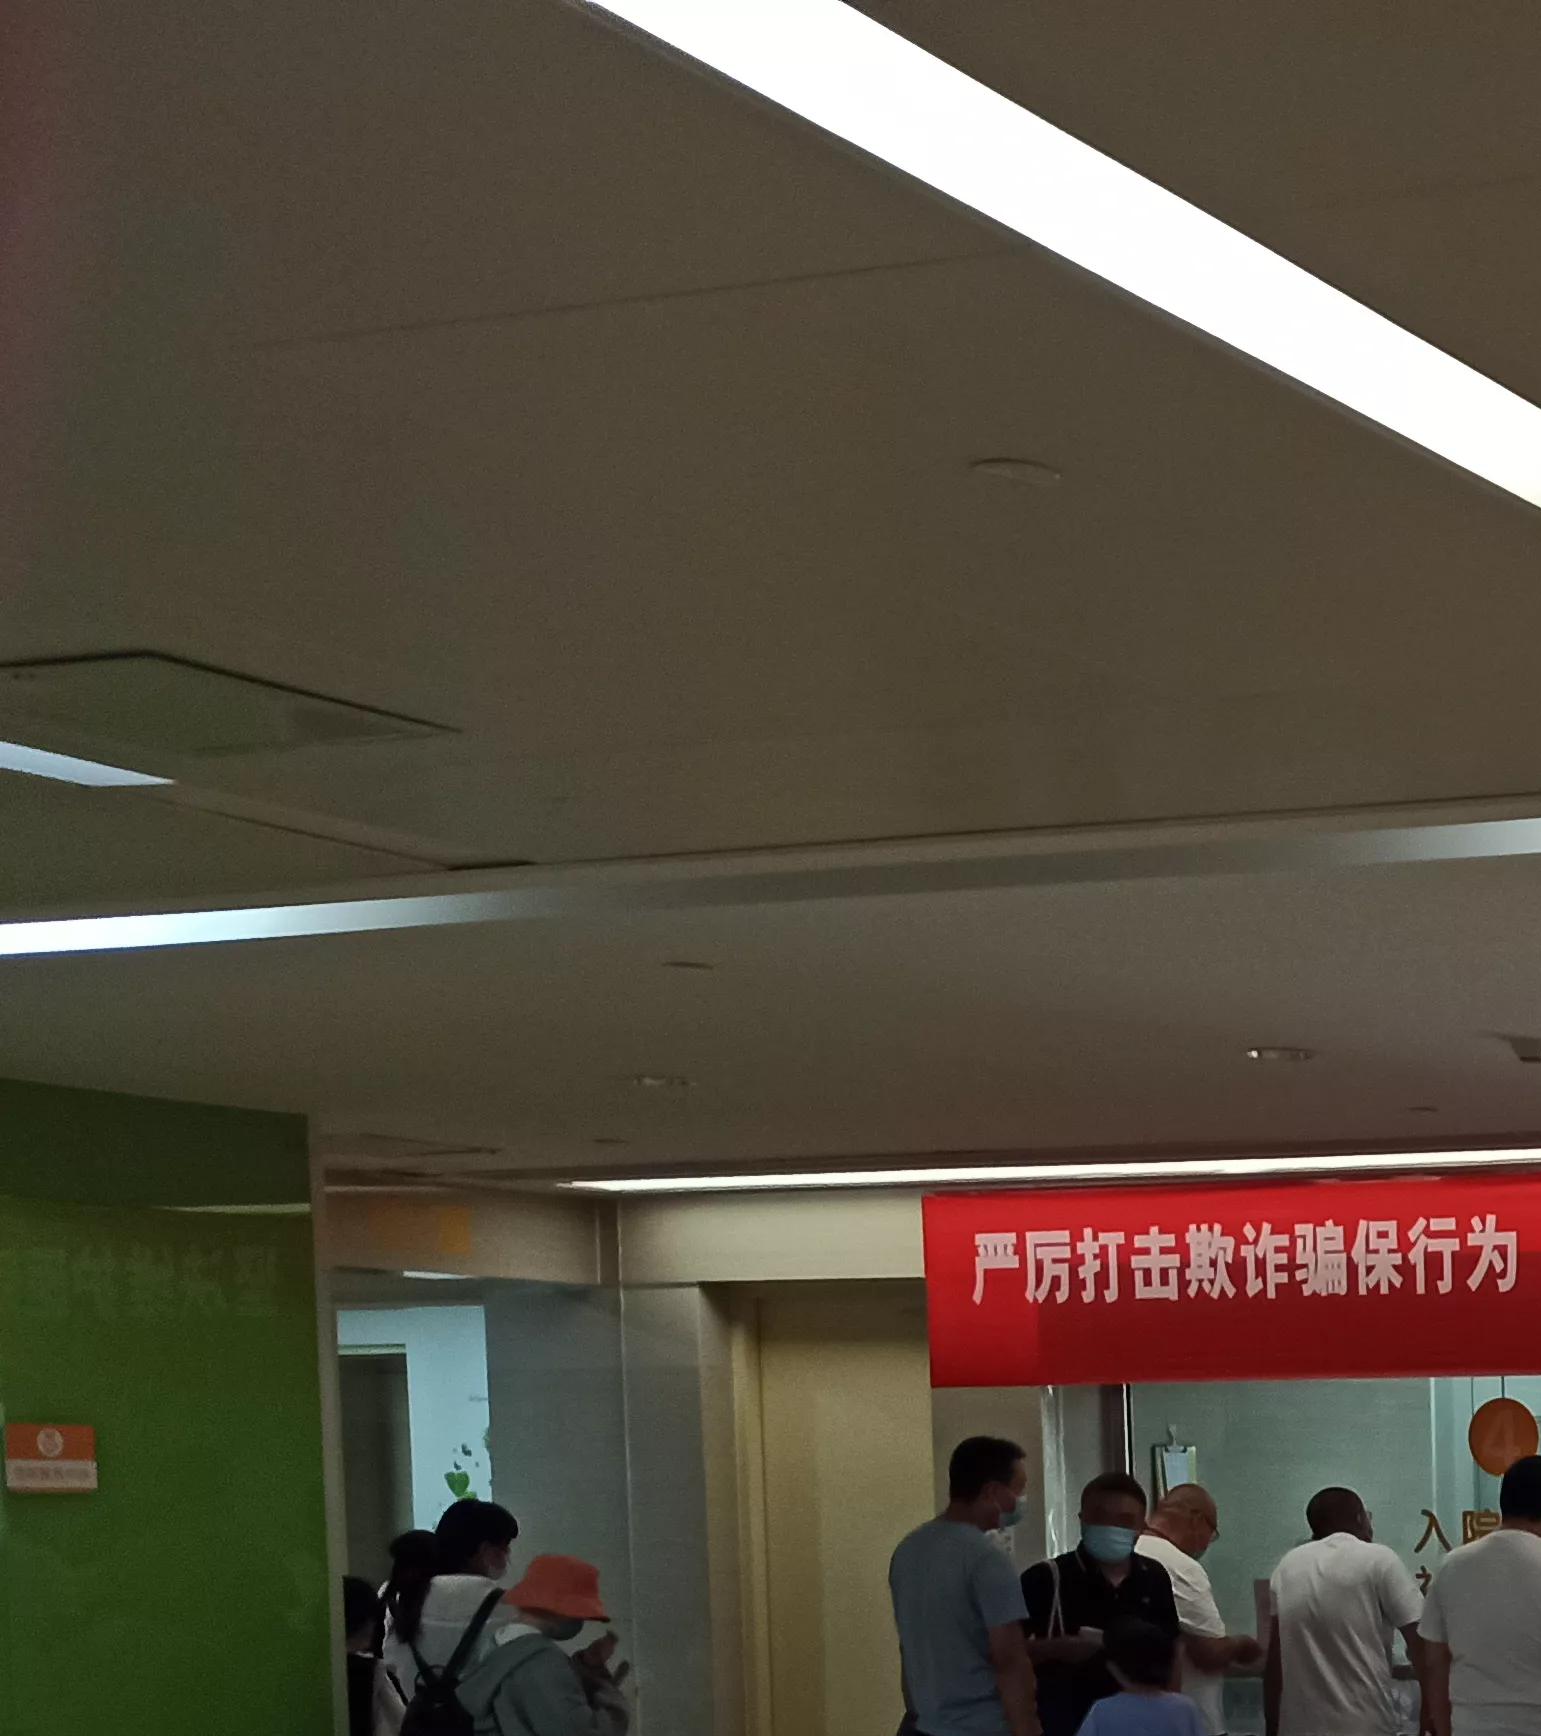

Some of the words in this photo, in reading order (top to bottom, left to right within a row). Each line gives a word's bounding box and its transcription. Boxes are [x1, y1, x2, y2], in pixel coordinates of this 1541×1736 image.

[973, 1214, 1518, 1305] 严厉打击欺诈骗保行为
